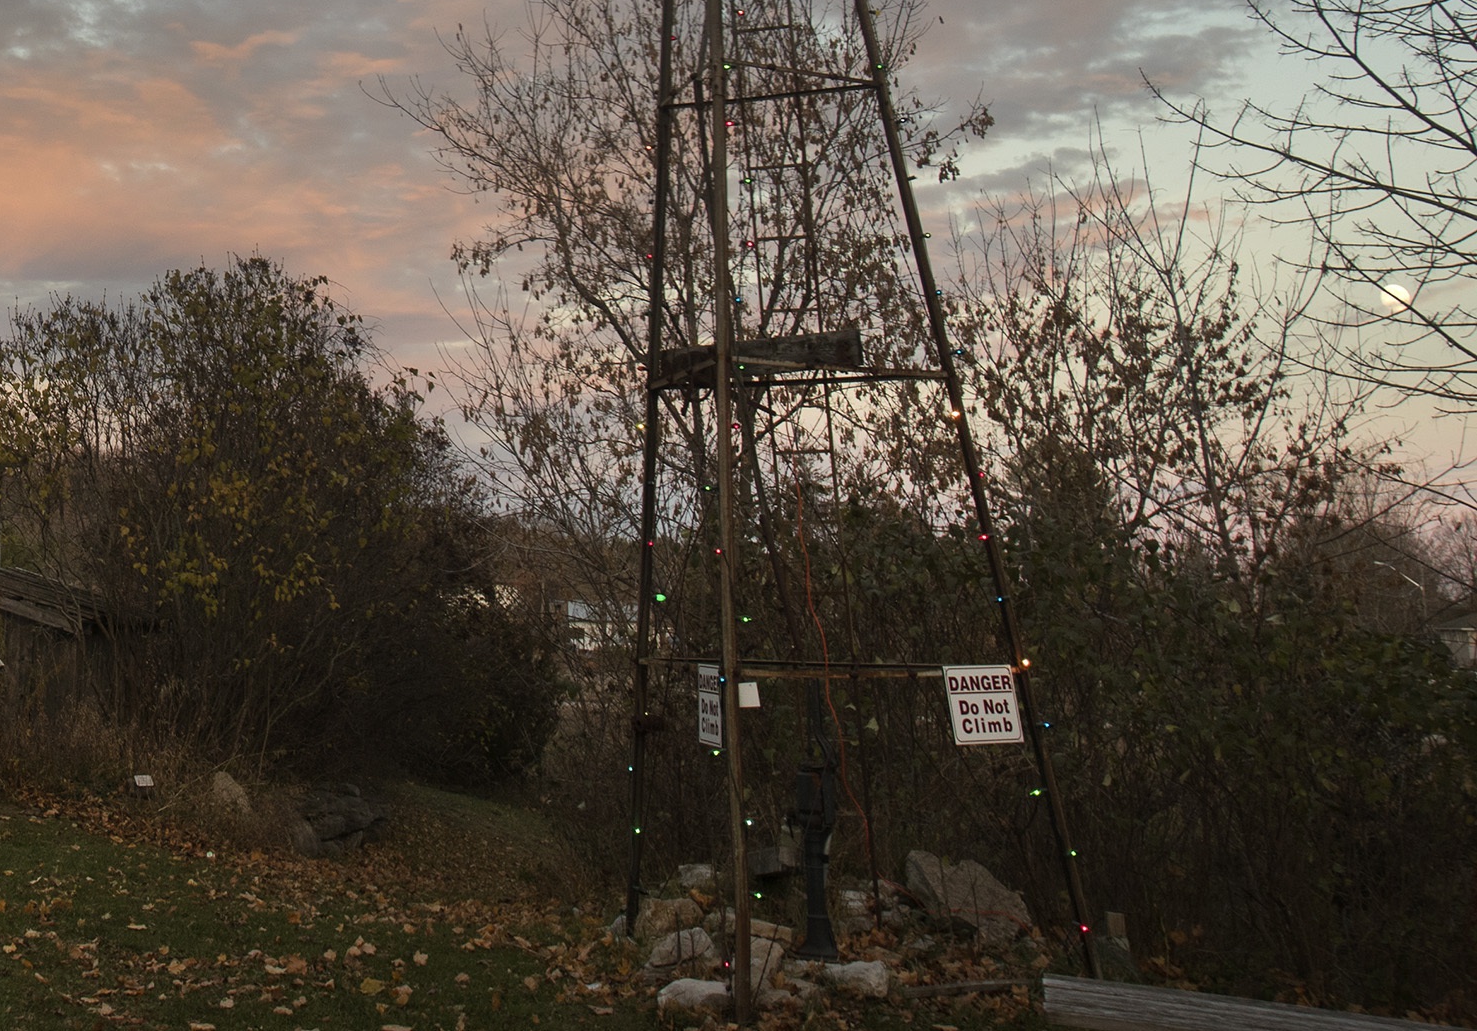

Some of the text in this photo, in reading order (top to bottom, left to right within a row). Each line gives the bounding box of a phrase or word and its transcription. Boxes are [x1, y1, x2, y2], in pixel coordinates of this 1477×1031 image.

[699, 674, 718, 691] DANGE
[948, 675, 1012, 691] DANGER
[701, 698, 719, 717] Do Not
[959, 699, 1010, 715] Do Not
[701, 717, 719, 737] Climb
[962, 717, 1013, 734] Climb
